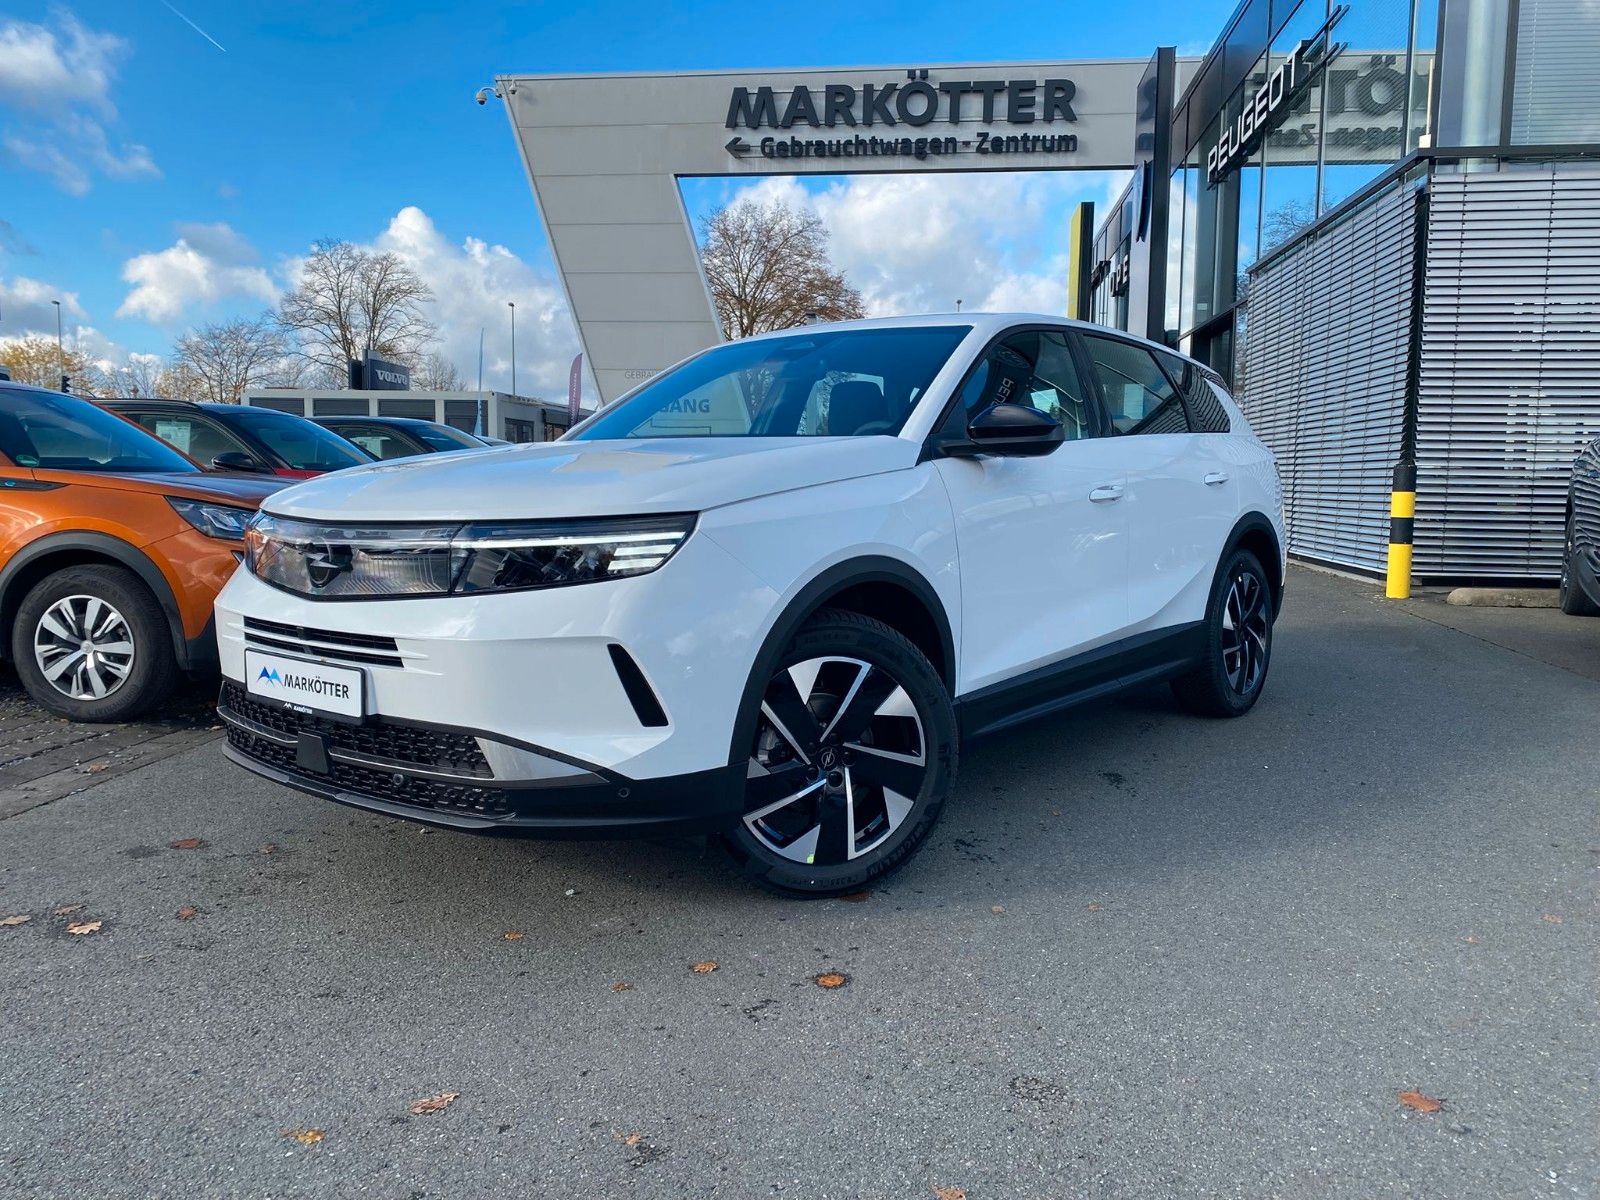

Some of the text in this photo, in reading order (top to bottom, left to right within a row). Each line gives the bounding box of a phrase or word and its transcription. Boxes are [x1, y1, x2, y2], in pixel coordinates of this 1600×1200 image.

[725, 69, 1078, 129] MARKÖTTER
[1207, 40, 1303, 182] PEUGEOT
[760, 134, 957, 160] Gebrauchtwagen
[976, 132, 1078, 155] Zentrum
[1109, 254, 1128, 297] OPE
[375, 369, 408, 386] VOLVO
[284, 674, 349, 699] MARKÖTTER
